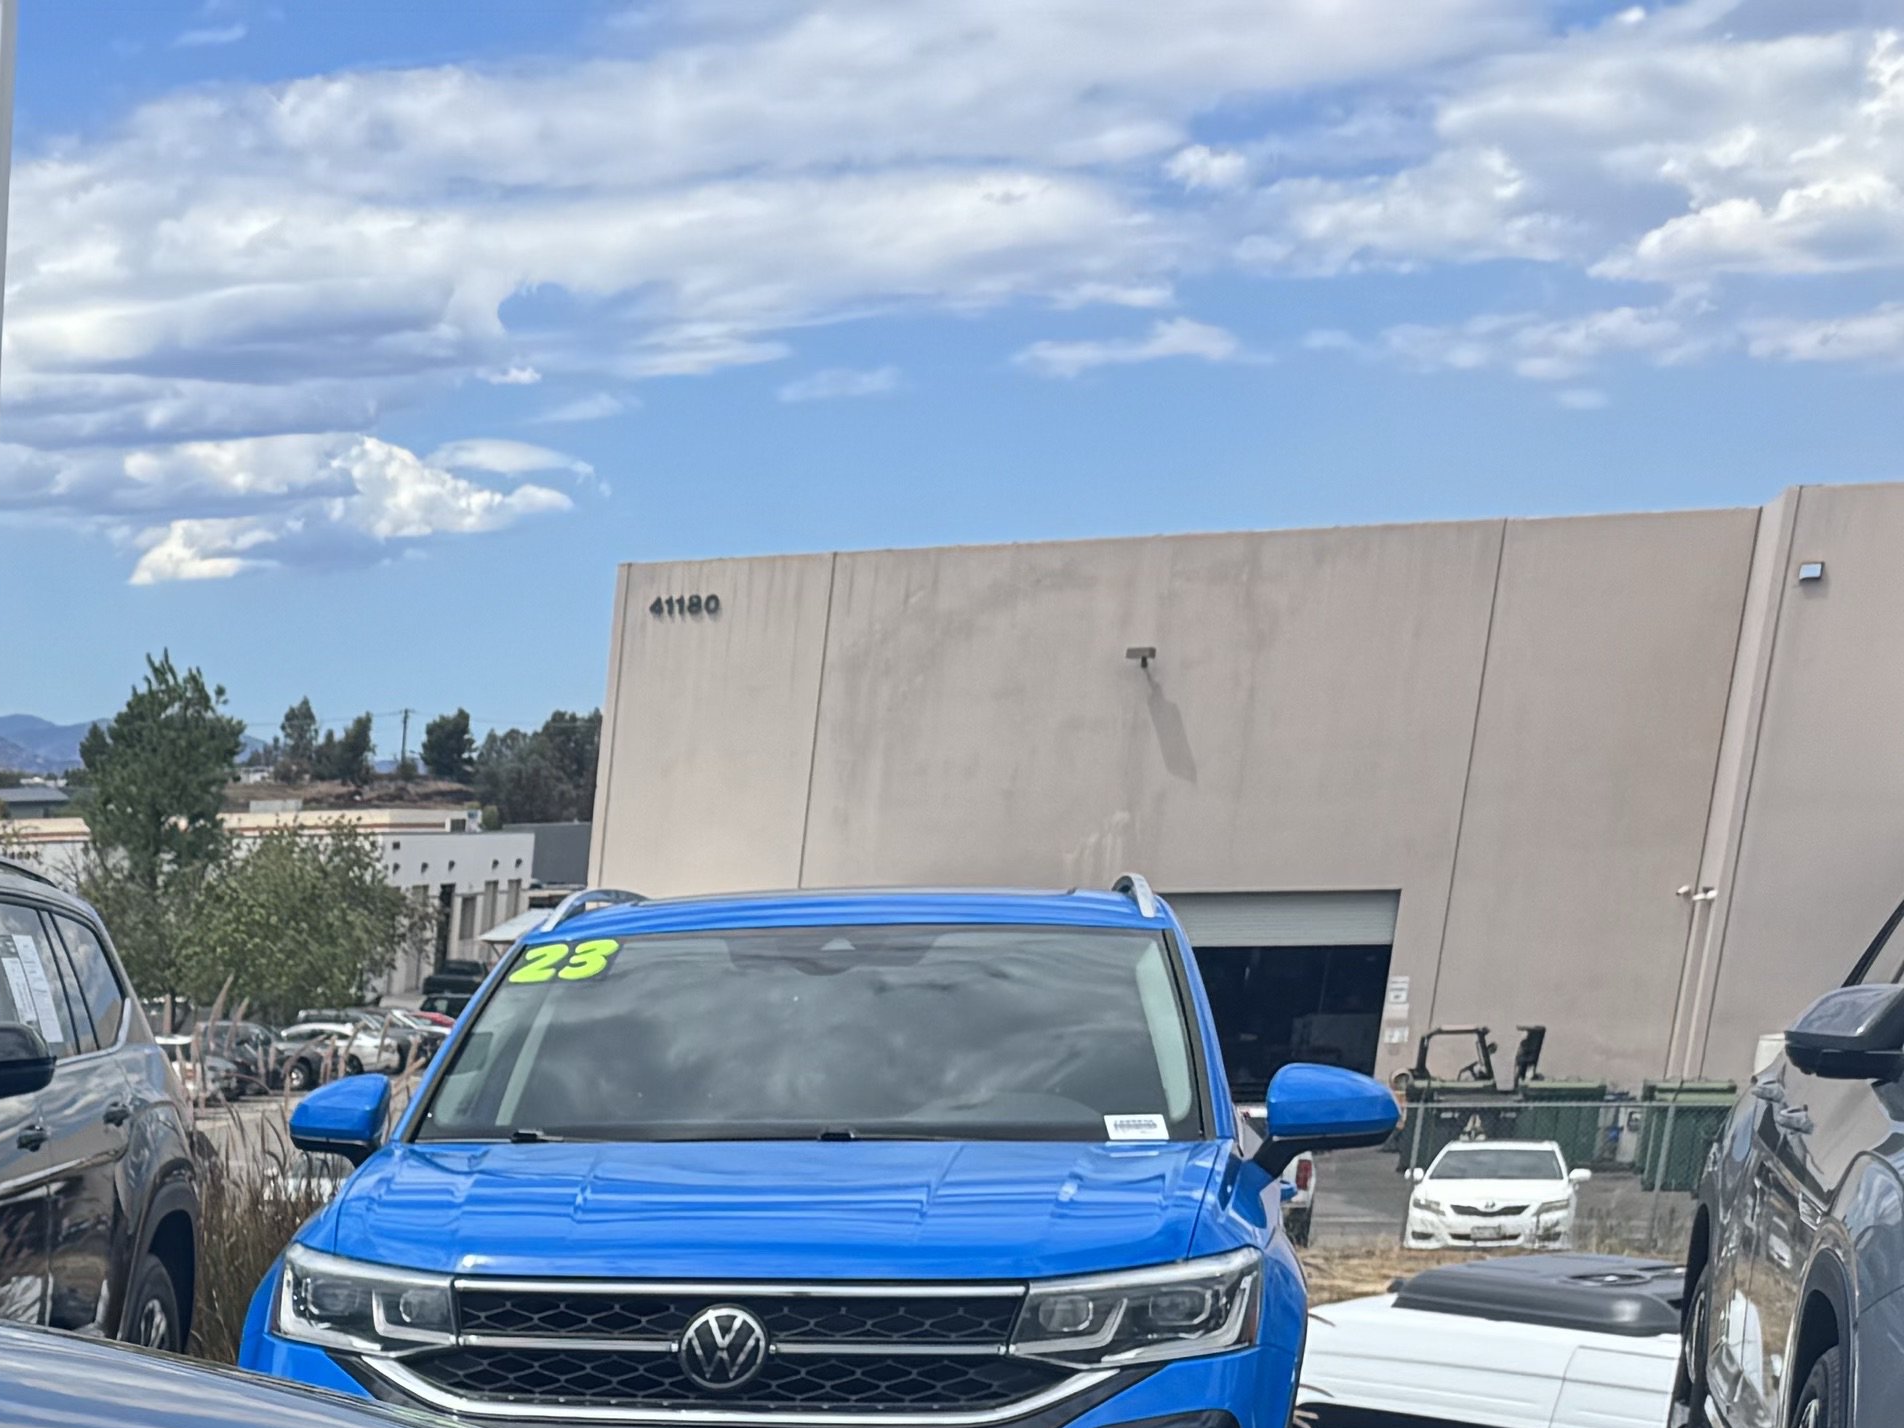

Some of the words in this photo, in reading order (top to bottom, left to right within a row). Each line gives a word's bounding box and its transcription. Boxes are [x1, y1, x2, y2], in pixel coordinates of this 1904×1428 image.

[649, 594, 721, 617] 41180
[508, 938, 620, 983] 23
[681, 1307, 766, 1390] VW
